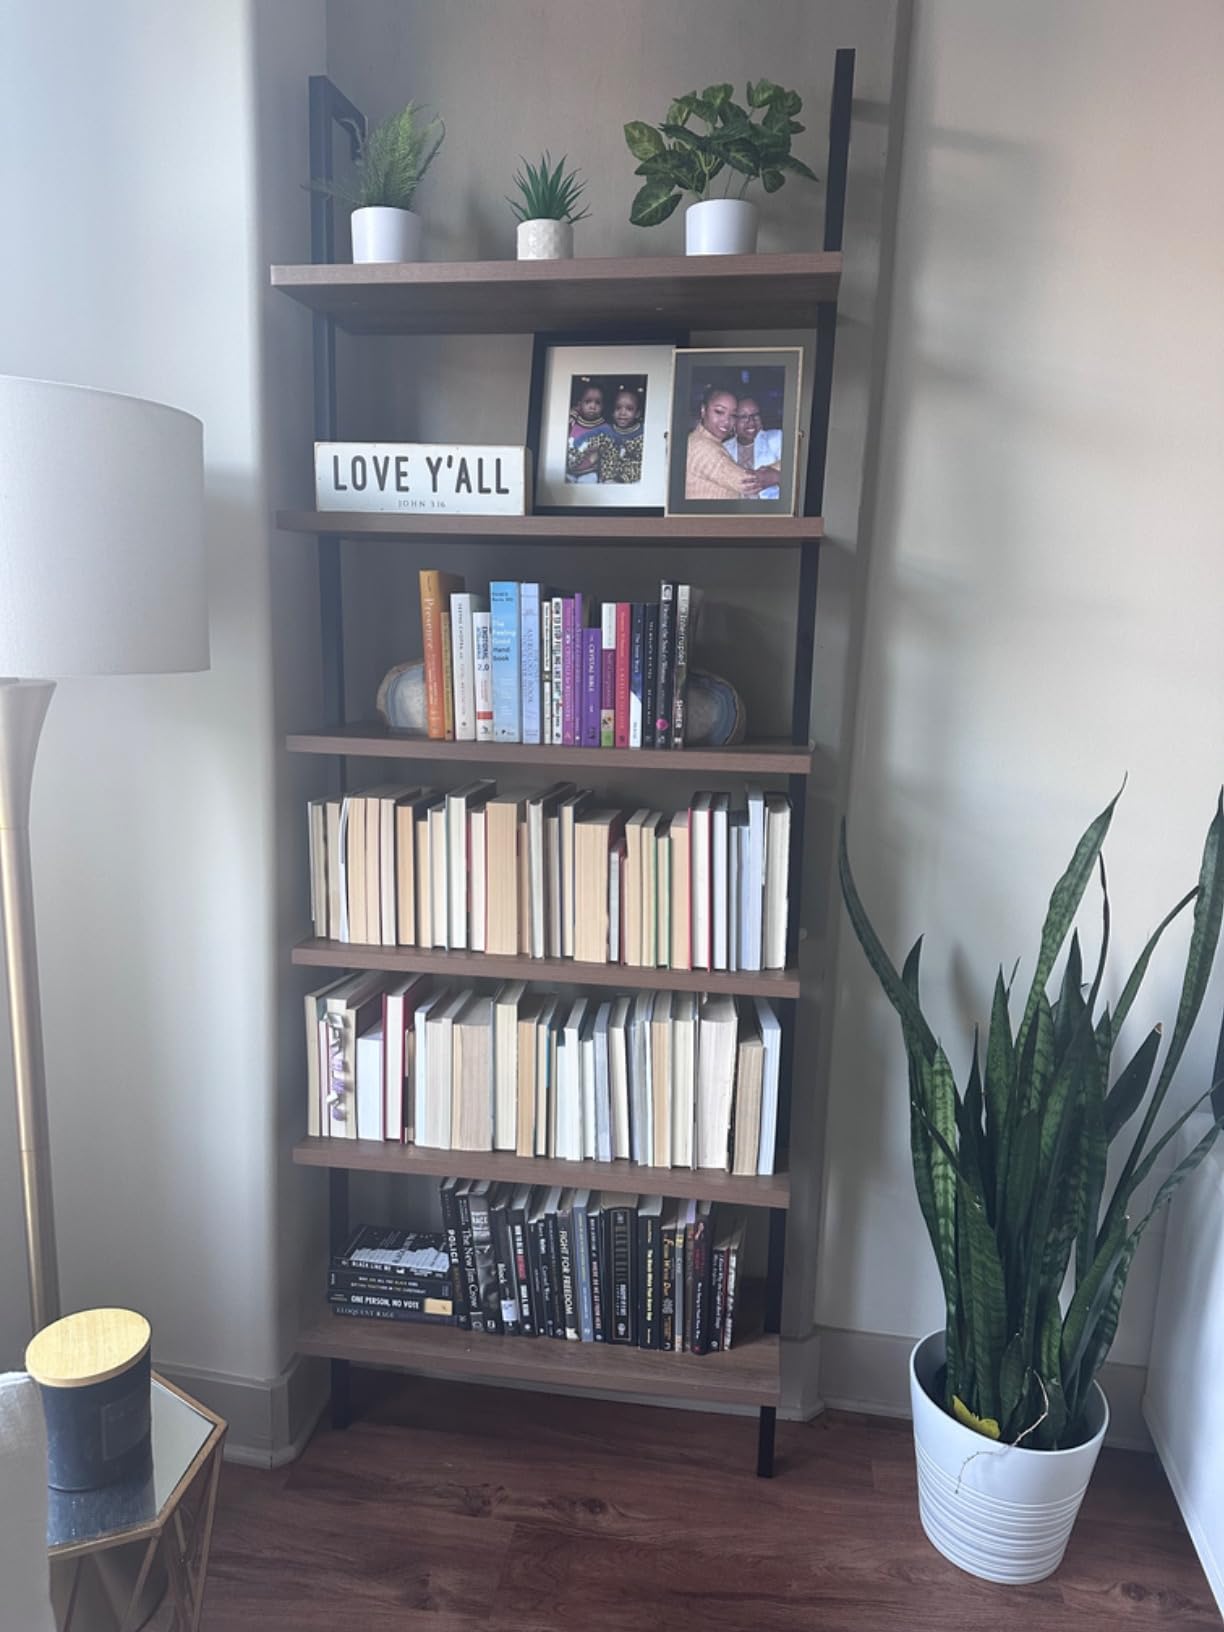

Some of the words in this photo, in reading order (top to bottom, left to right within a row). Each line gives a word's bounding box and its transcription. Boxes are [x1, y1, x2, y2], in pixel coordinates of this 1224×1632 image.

[333, 455, 409, 492] LOVE
[426, 455, 509, 494] Y'ALL
[424, 597, 435, 650] Presence
[677, 615, 686, 665] Interrupted
[448, 1229, 459, 1264] POLICE
[462, 1229, 472, 1246] The
[559, 1230, 568, 1255] FIGHT
[464, 1247, 474, 1266] New
[562, 1257, 570, 1272] FOR
[465, 1268, 476, 1283] Jim
[351, 1295, 363, 1303] ONE
[365, 1297, 390, 1307] PERSON,
[404, 1301, 419, 1309] VOTE
[468, 1284, 479, 1308] Crow
[563, 1275, 572, 1314] FREEDOM
